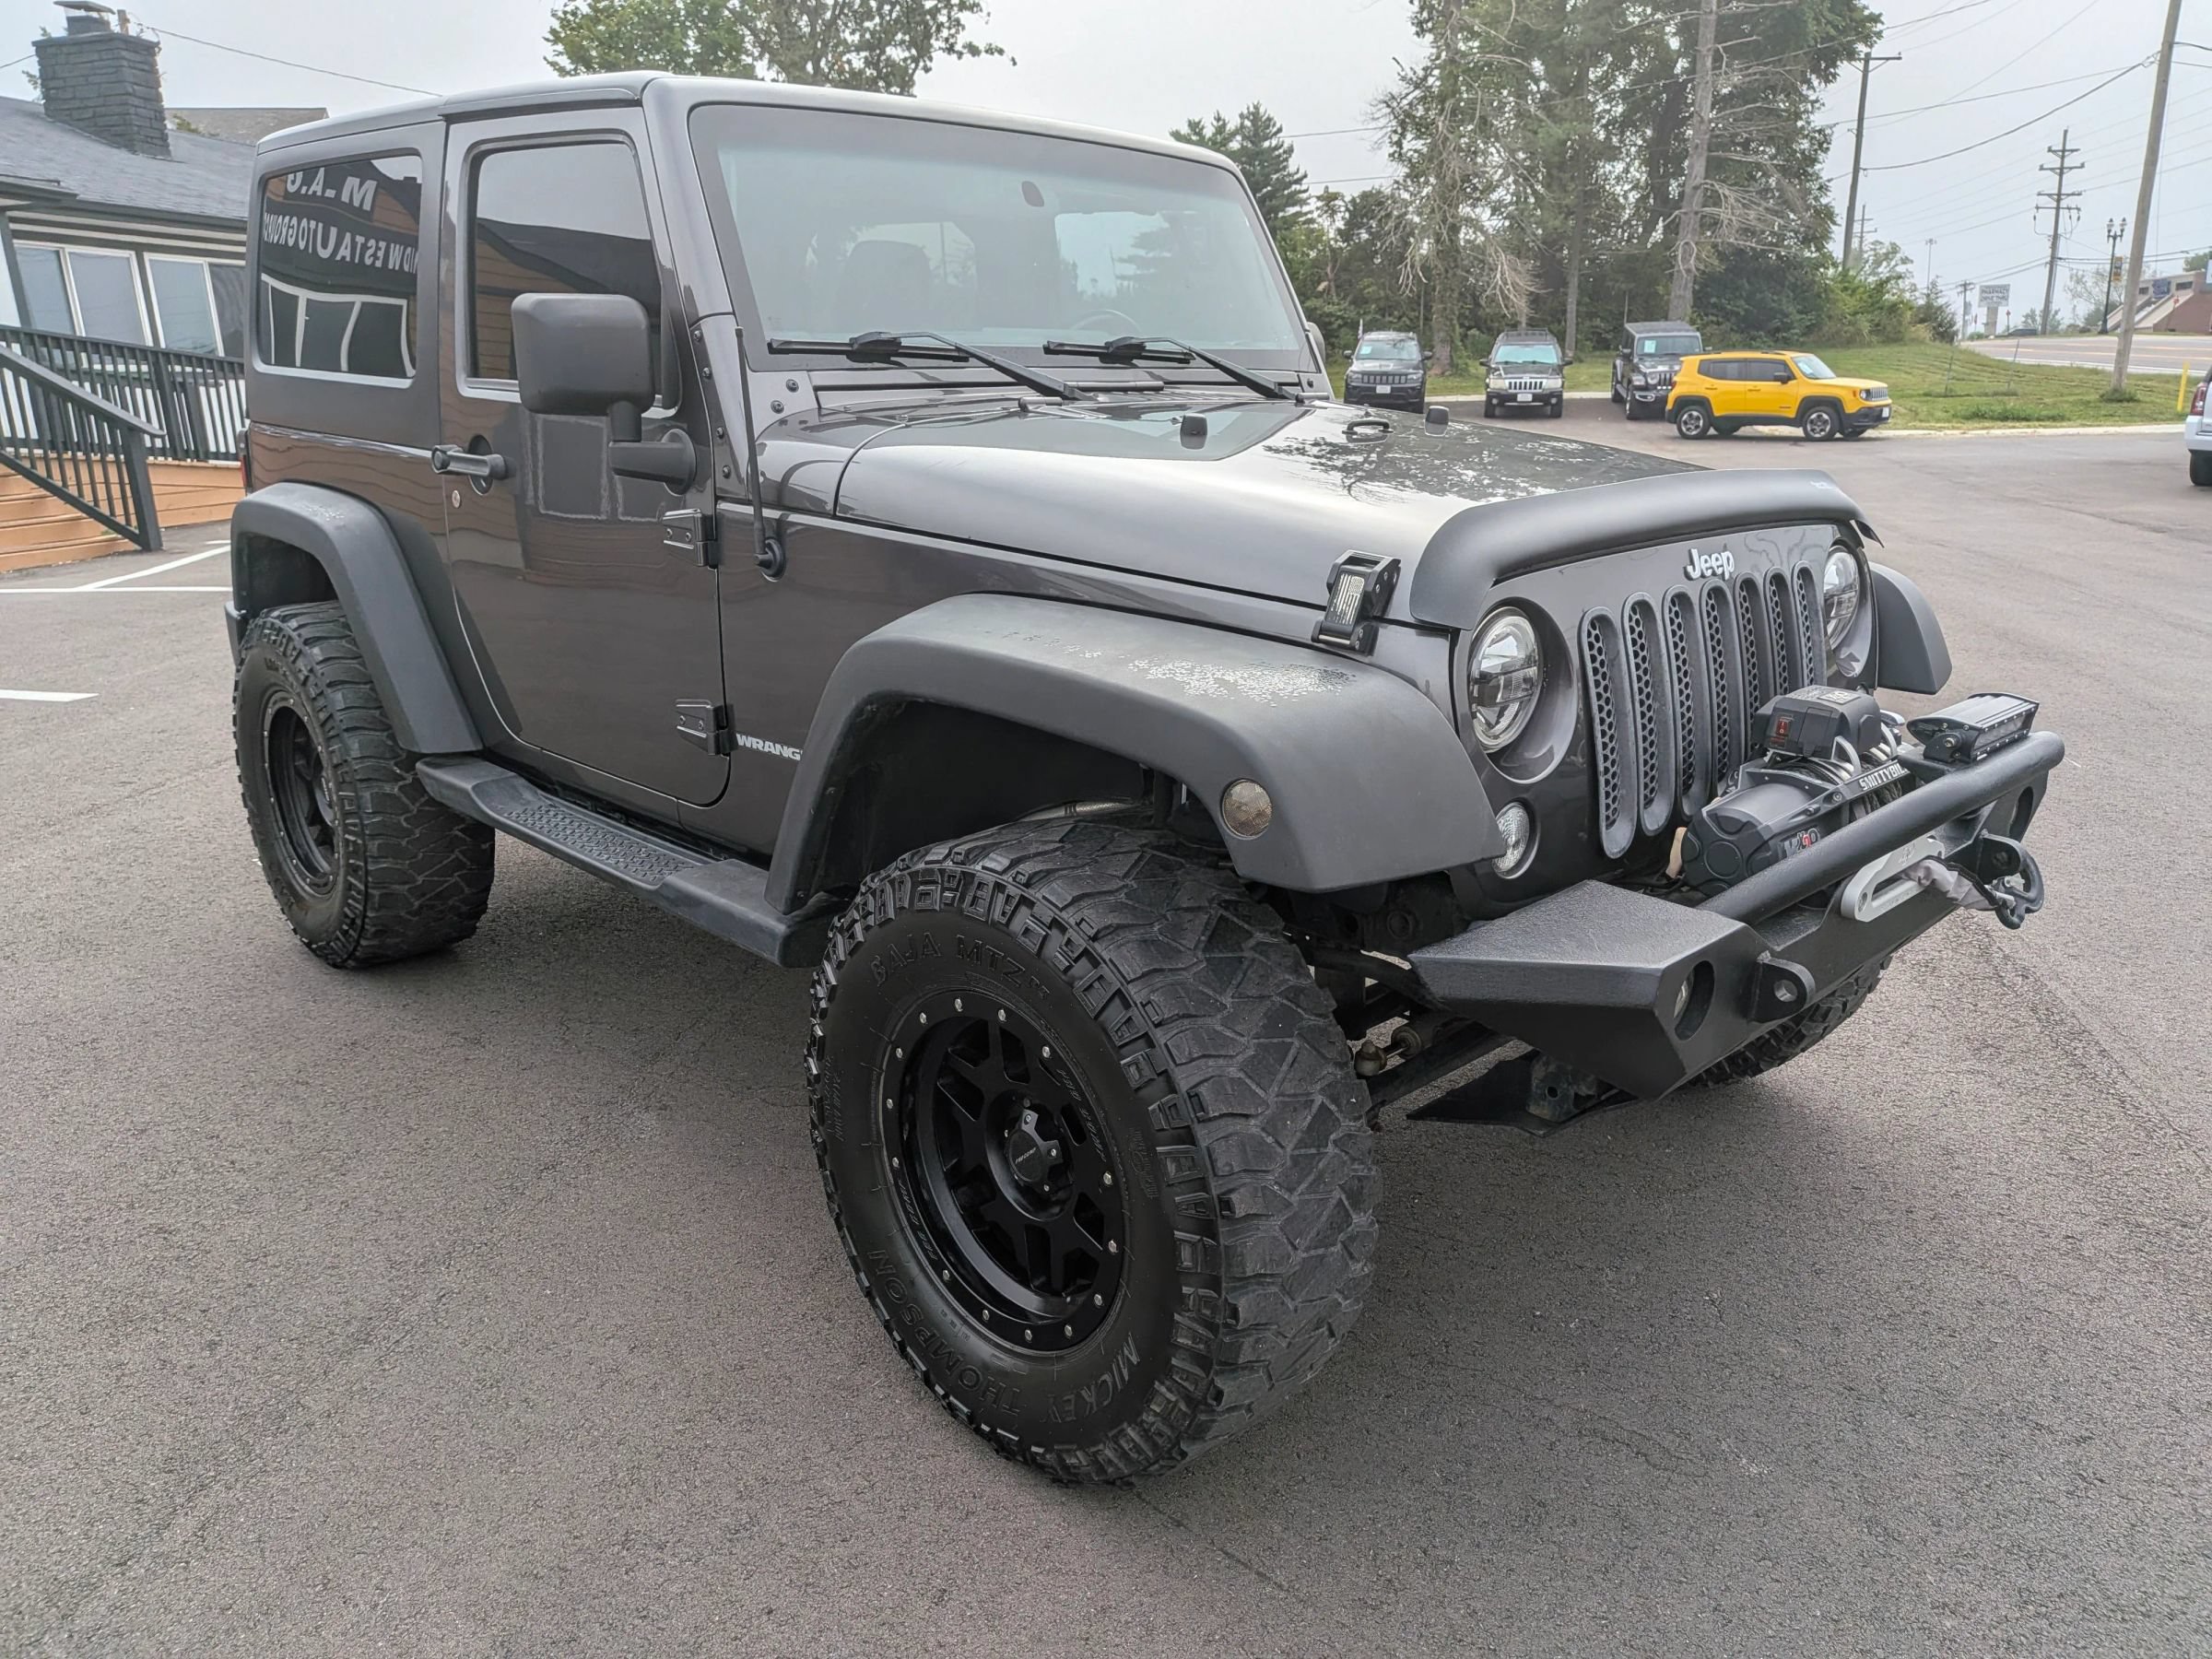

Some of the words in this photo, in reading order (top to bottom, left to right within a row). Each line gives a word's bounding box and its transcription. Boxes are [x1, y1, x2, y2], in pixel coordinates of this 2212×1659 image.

[1686, 547, 1735, 581] Jeep
[735, 733, 803, 761] WRANG
[1858, 762, 1909, 791] SMITTYBIL
[870, 932, 943, 987] BAJA
[956, 934, 1026, 987] MTZ
[867, 1249, 1023, 1417] THOMPSON
[1041, 1331, 1142, 1424] MICKEY
